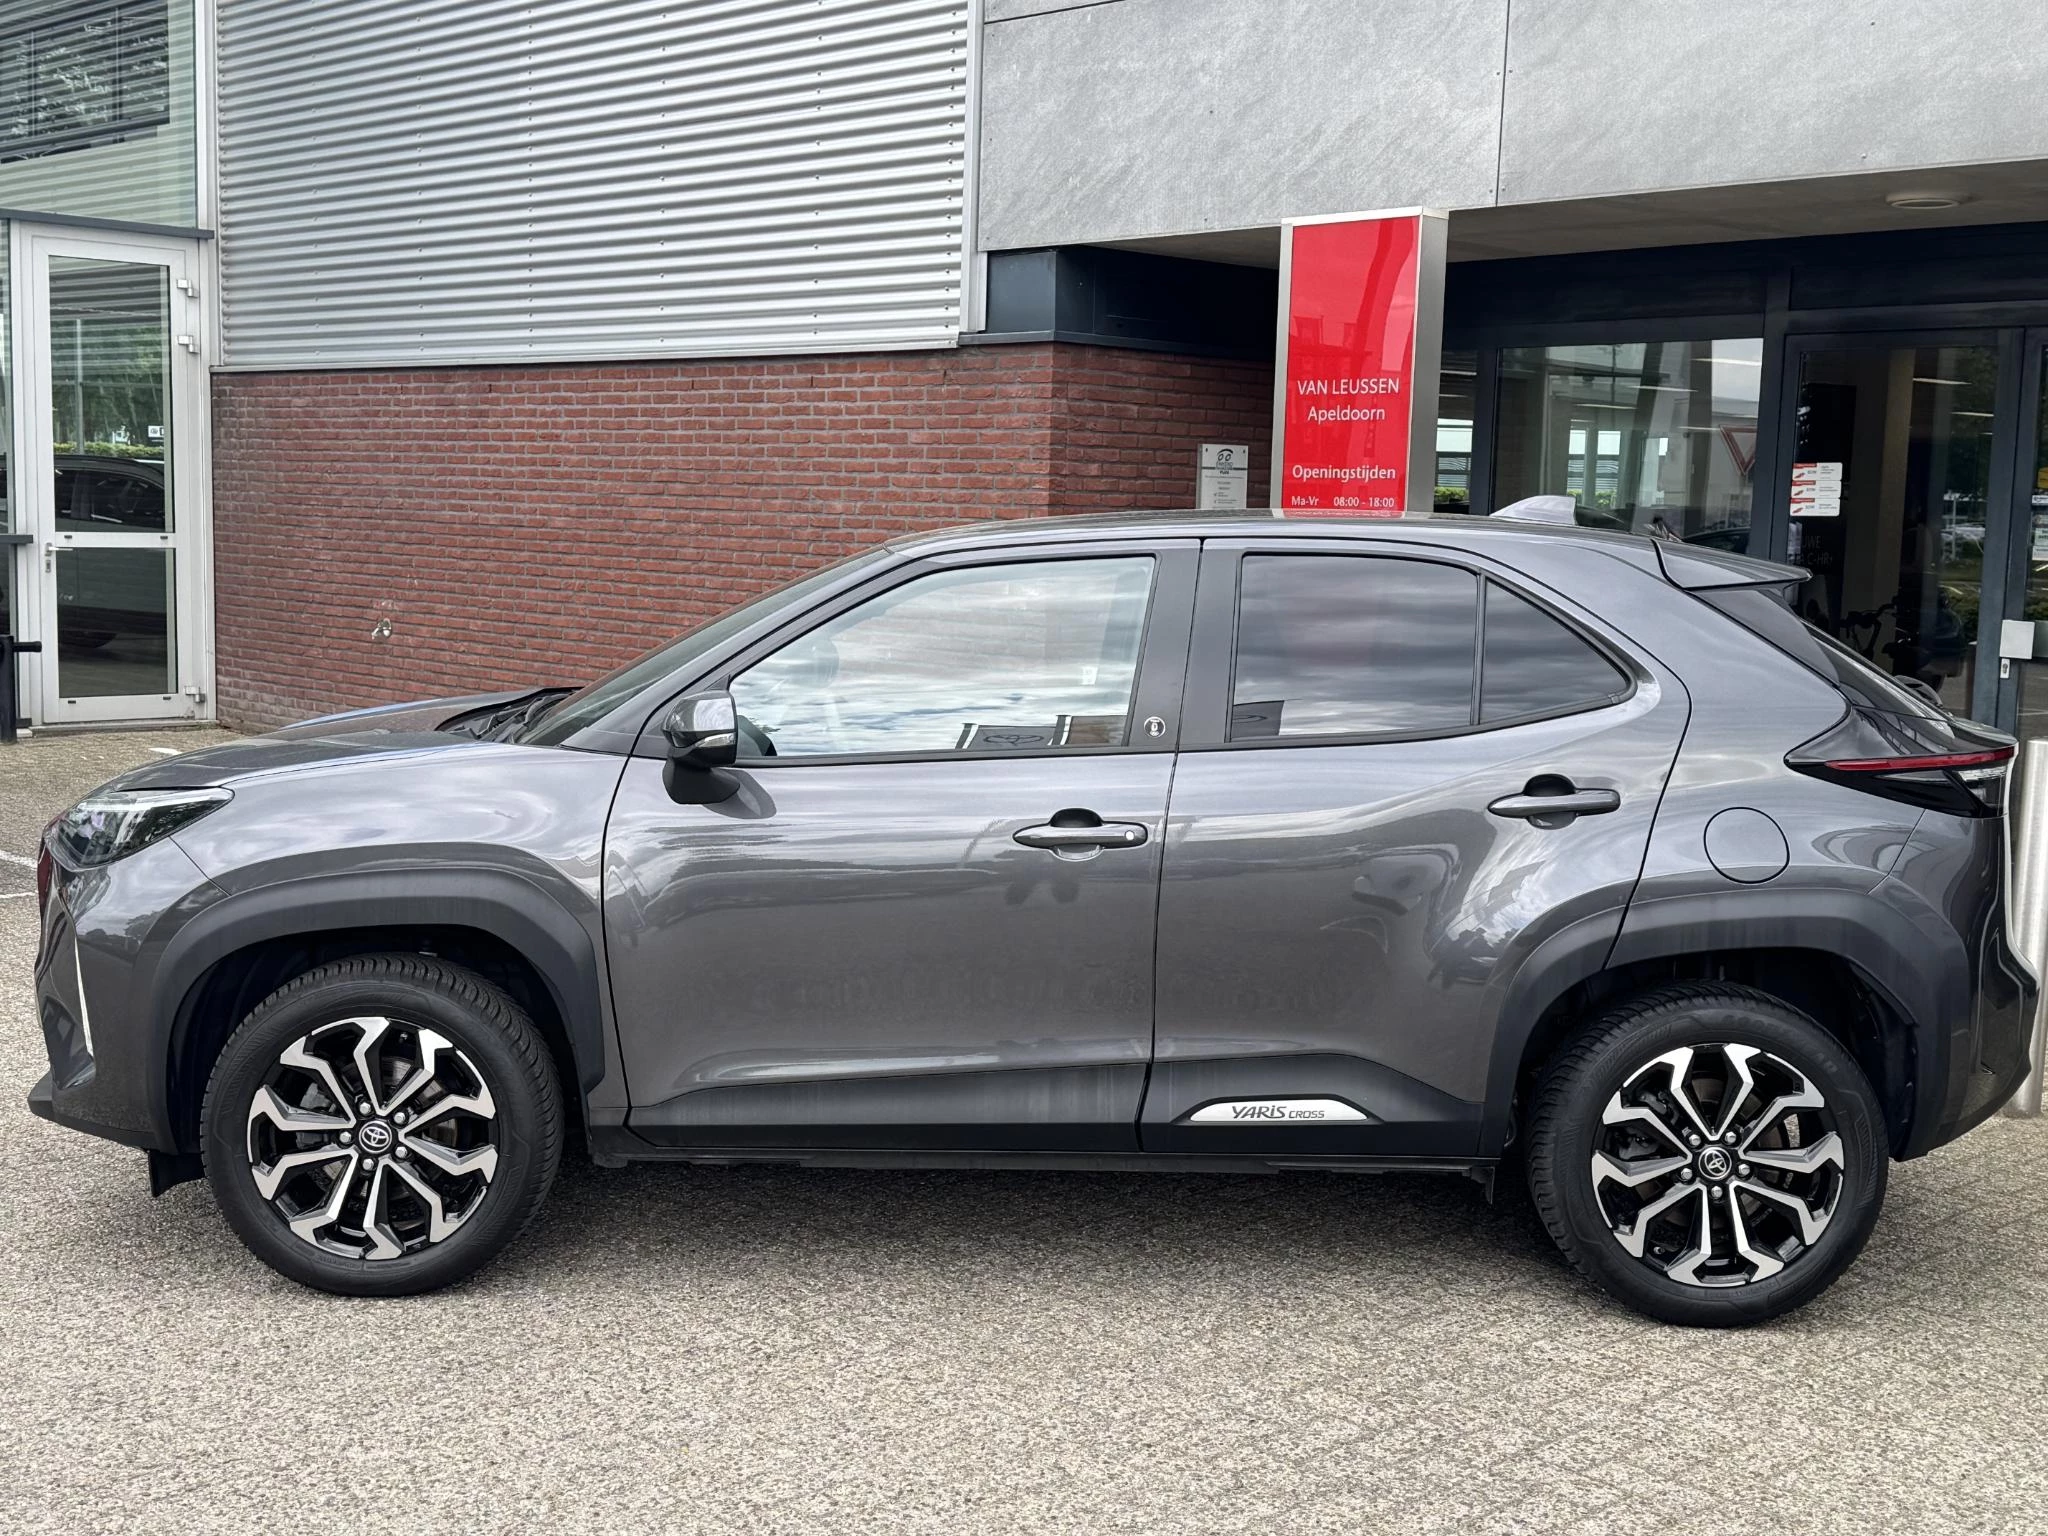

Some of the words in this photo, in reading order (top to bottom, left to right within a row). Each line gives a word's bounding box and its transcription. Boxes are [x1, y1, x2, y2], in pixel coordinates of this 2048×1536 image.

[1297, 379, 1328, 396] VAN
[1332, 377, 1400, 395] LEUSSEN
[1307, 404, 1386, 425] Apeldoorn
[1292, 464, 1396, 483] Openingstijden
[1291, 495, 1320, 506] Ma-Vr
[1333, 496, 1360, 507] 08:00
[1368, 497, 1395, 508] 18:00
[1288, 1110, 1325, 1119] CROSS
